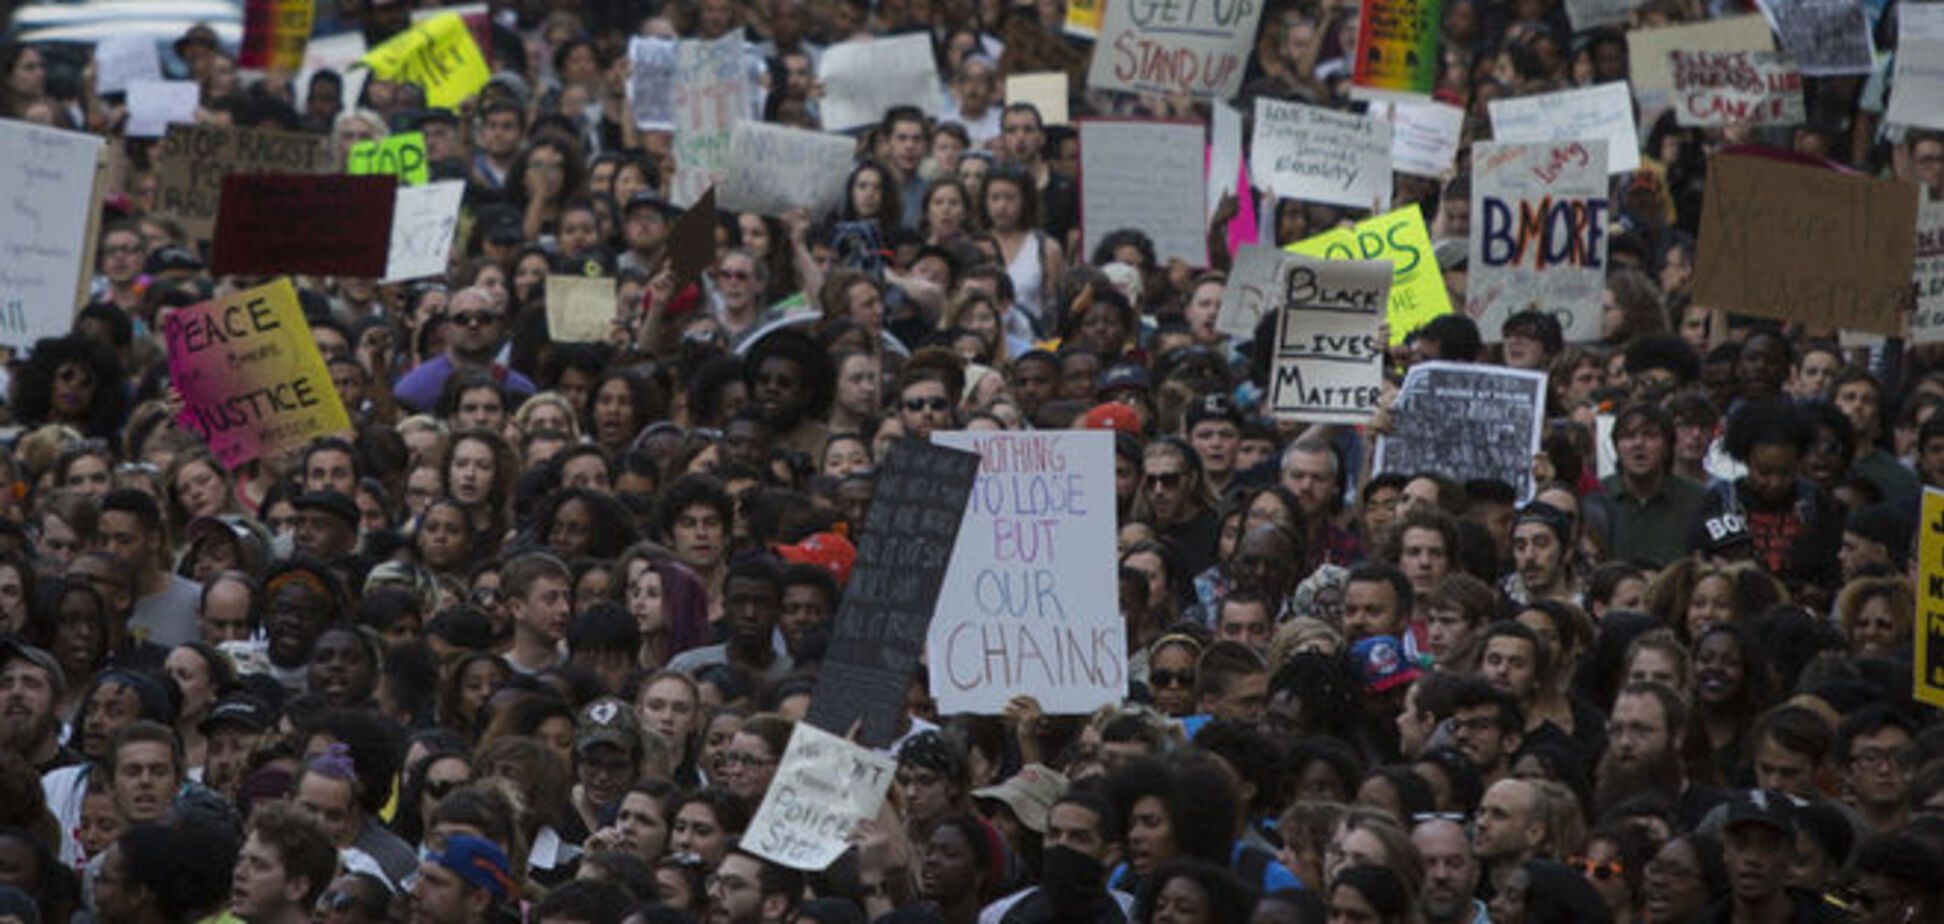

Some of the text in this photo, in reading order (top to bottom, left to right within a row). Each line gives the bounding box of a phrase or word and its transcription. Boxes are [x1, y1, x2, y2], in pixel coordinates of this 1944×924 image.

[1113, 29, 1239, 87] STAND UP
[1481, 194, 1607, 271] BMORE
[165, 297, 282, 360] PEACE
[191, 376, 320, 446] JUSTICE
[973, 434, 1067, 474] NOTHING
[972, 474, 1088, 516] TO LOSE
[993, 518, 1060, 564] BUT
[974, 567, 1068, 622] OUR
[945, 621, 1122, 692] CHAINS
